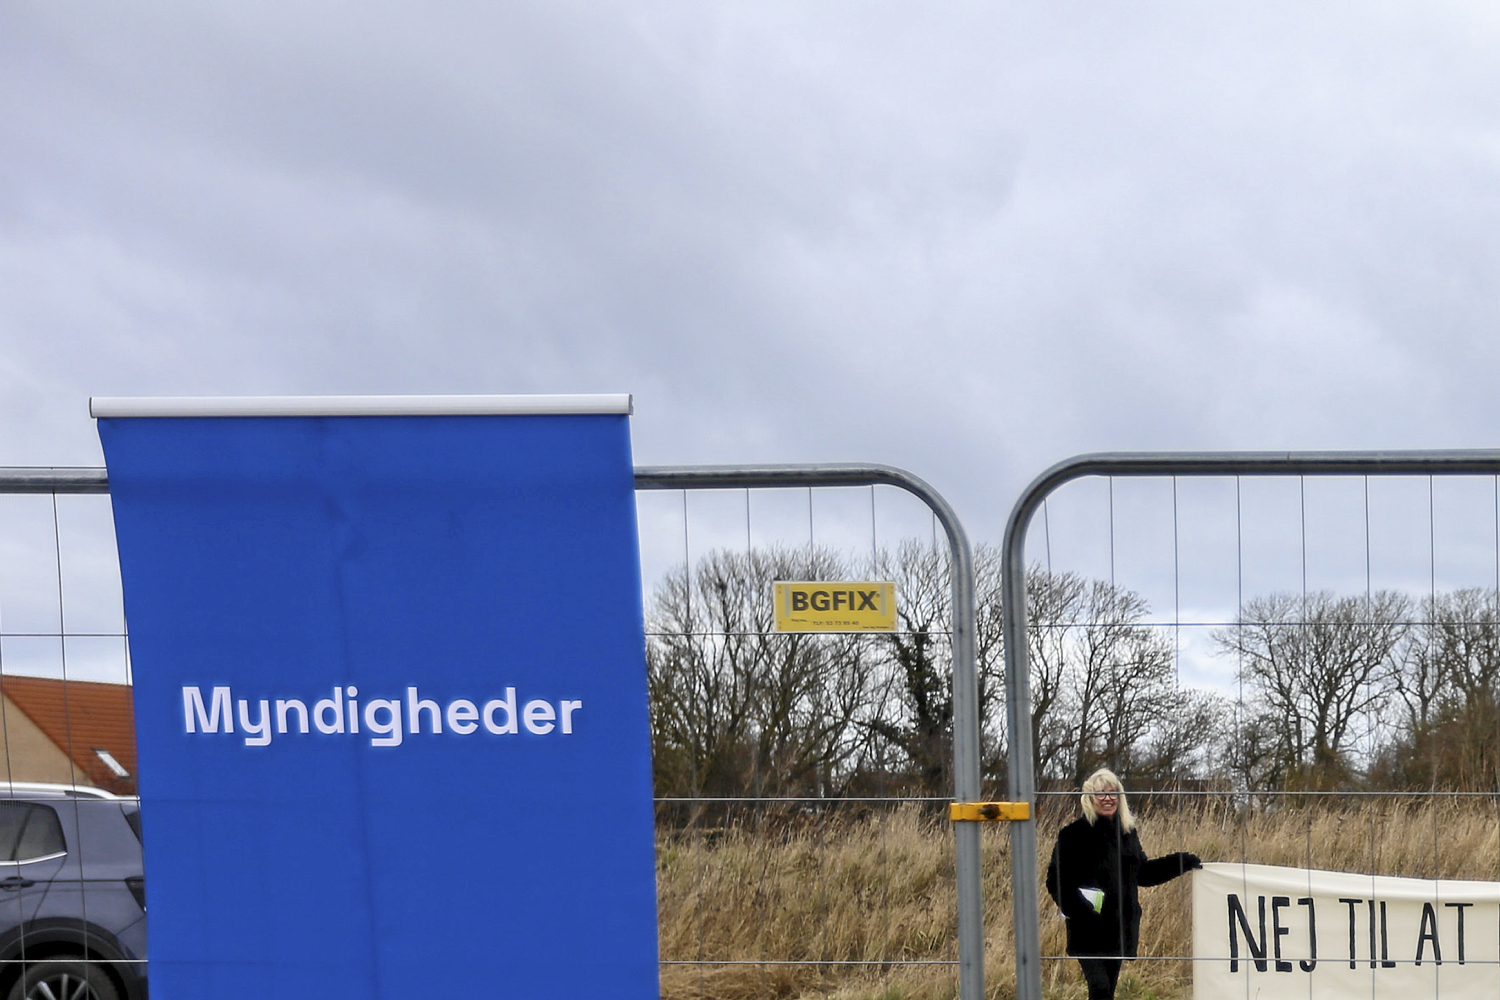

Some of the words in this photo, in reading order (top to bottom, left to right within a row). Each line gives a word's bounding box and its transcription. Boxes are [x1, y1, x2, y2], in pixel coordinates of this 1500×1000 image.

[183, 686, 582, 747] Myndigheder
[1227, 893, 1317, 973] NEJ
[1338, 898, 1396, 969] TIL
[1415, 902, 1474, 966] AT
